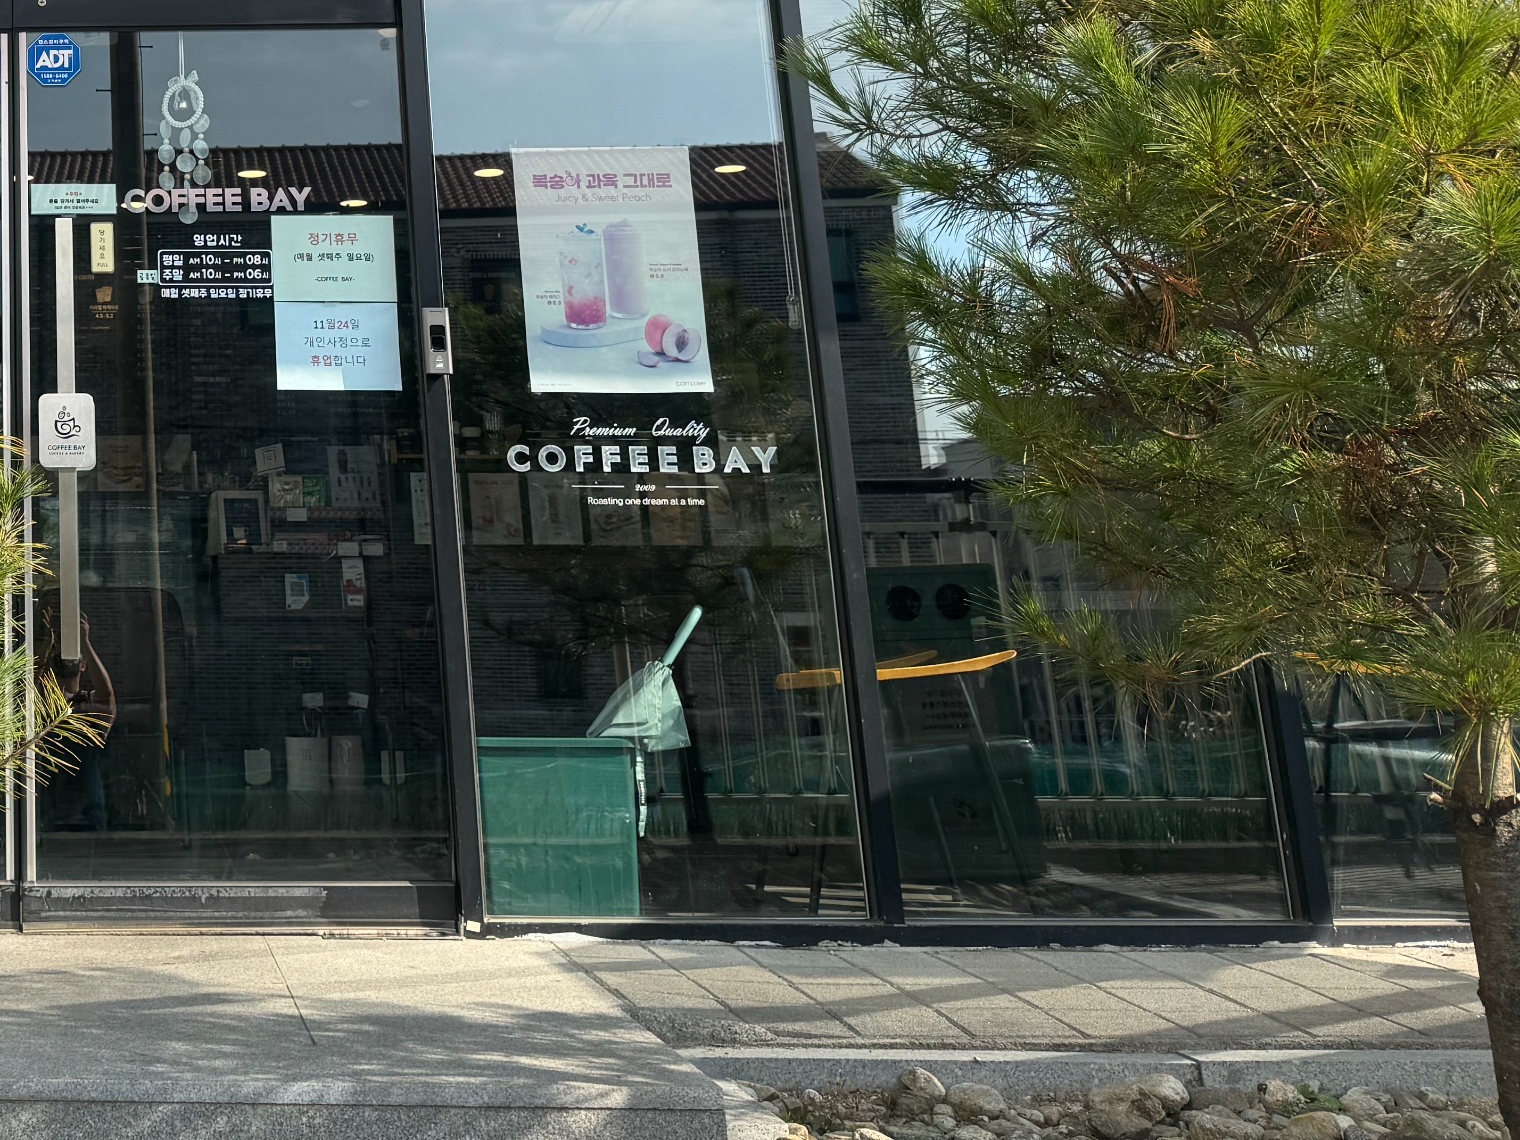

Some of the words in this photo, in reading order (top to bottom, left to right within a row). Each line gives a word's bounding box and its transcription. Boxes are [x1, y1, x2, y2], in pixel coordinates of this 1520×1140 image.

[35, 49, 73, 69] ADT
[532, 171, 581, 189] 복숭아
[585, 173, 618, 189] 과육
[623, 172, 672, 189] 그대로
[124, 187, 242, 213] COFFEE
[250, 186, 312, 212] BAY
[555, 194, 578, 204] Juicy
[581, 194, 588, 202] &
[591, 193, 619, 202] Sweet
[622, 193, 651, 202] Peach
[98, 229, 106, 260] 당기세요
[193, 234, 242, 247] 영업시간
[308, 233, 358, 246] 정기휴무
[162, 254, 183, 266] 평일
[293, 253, 313, 262] (매월
[317, 253, 342, 262] 셋째주
[346, 253, 374, 262] 일요일)
[162, 269, 183, 281] 주말
[161, 288, 178, 298] 매월
[181, 288, 207, 298] 셋째주
[210, 288, 236, 298] 일요일
[239, 288, 273, 298] 정기휴무
[313, 319, 360, 330] 11월24일
[304, 336, 371, 348] 개인사정으로
[310, 355, 366, 367] 휴업합니다
[570, 416, 636, 437] Premium
[651, 417, 710, 444] Quality
[506, 444, 679, 473] COFFEE
[692, 446, 777, 473] BAY
[634, 483, 656, 492] 2009
[587, 497, 624, 507] Roasting
[642, 497, 669, 505] dream
[670, 497, 679, 505] at
[687, 497, 705, 506] time
